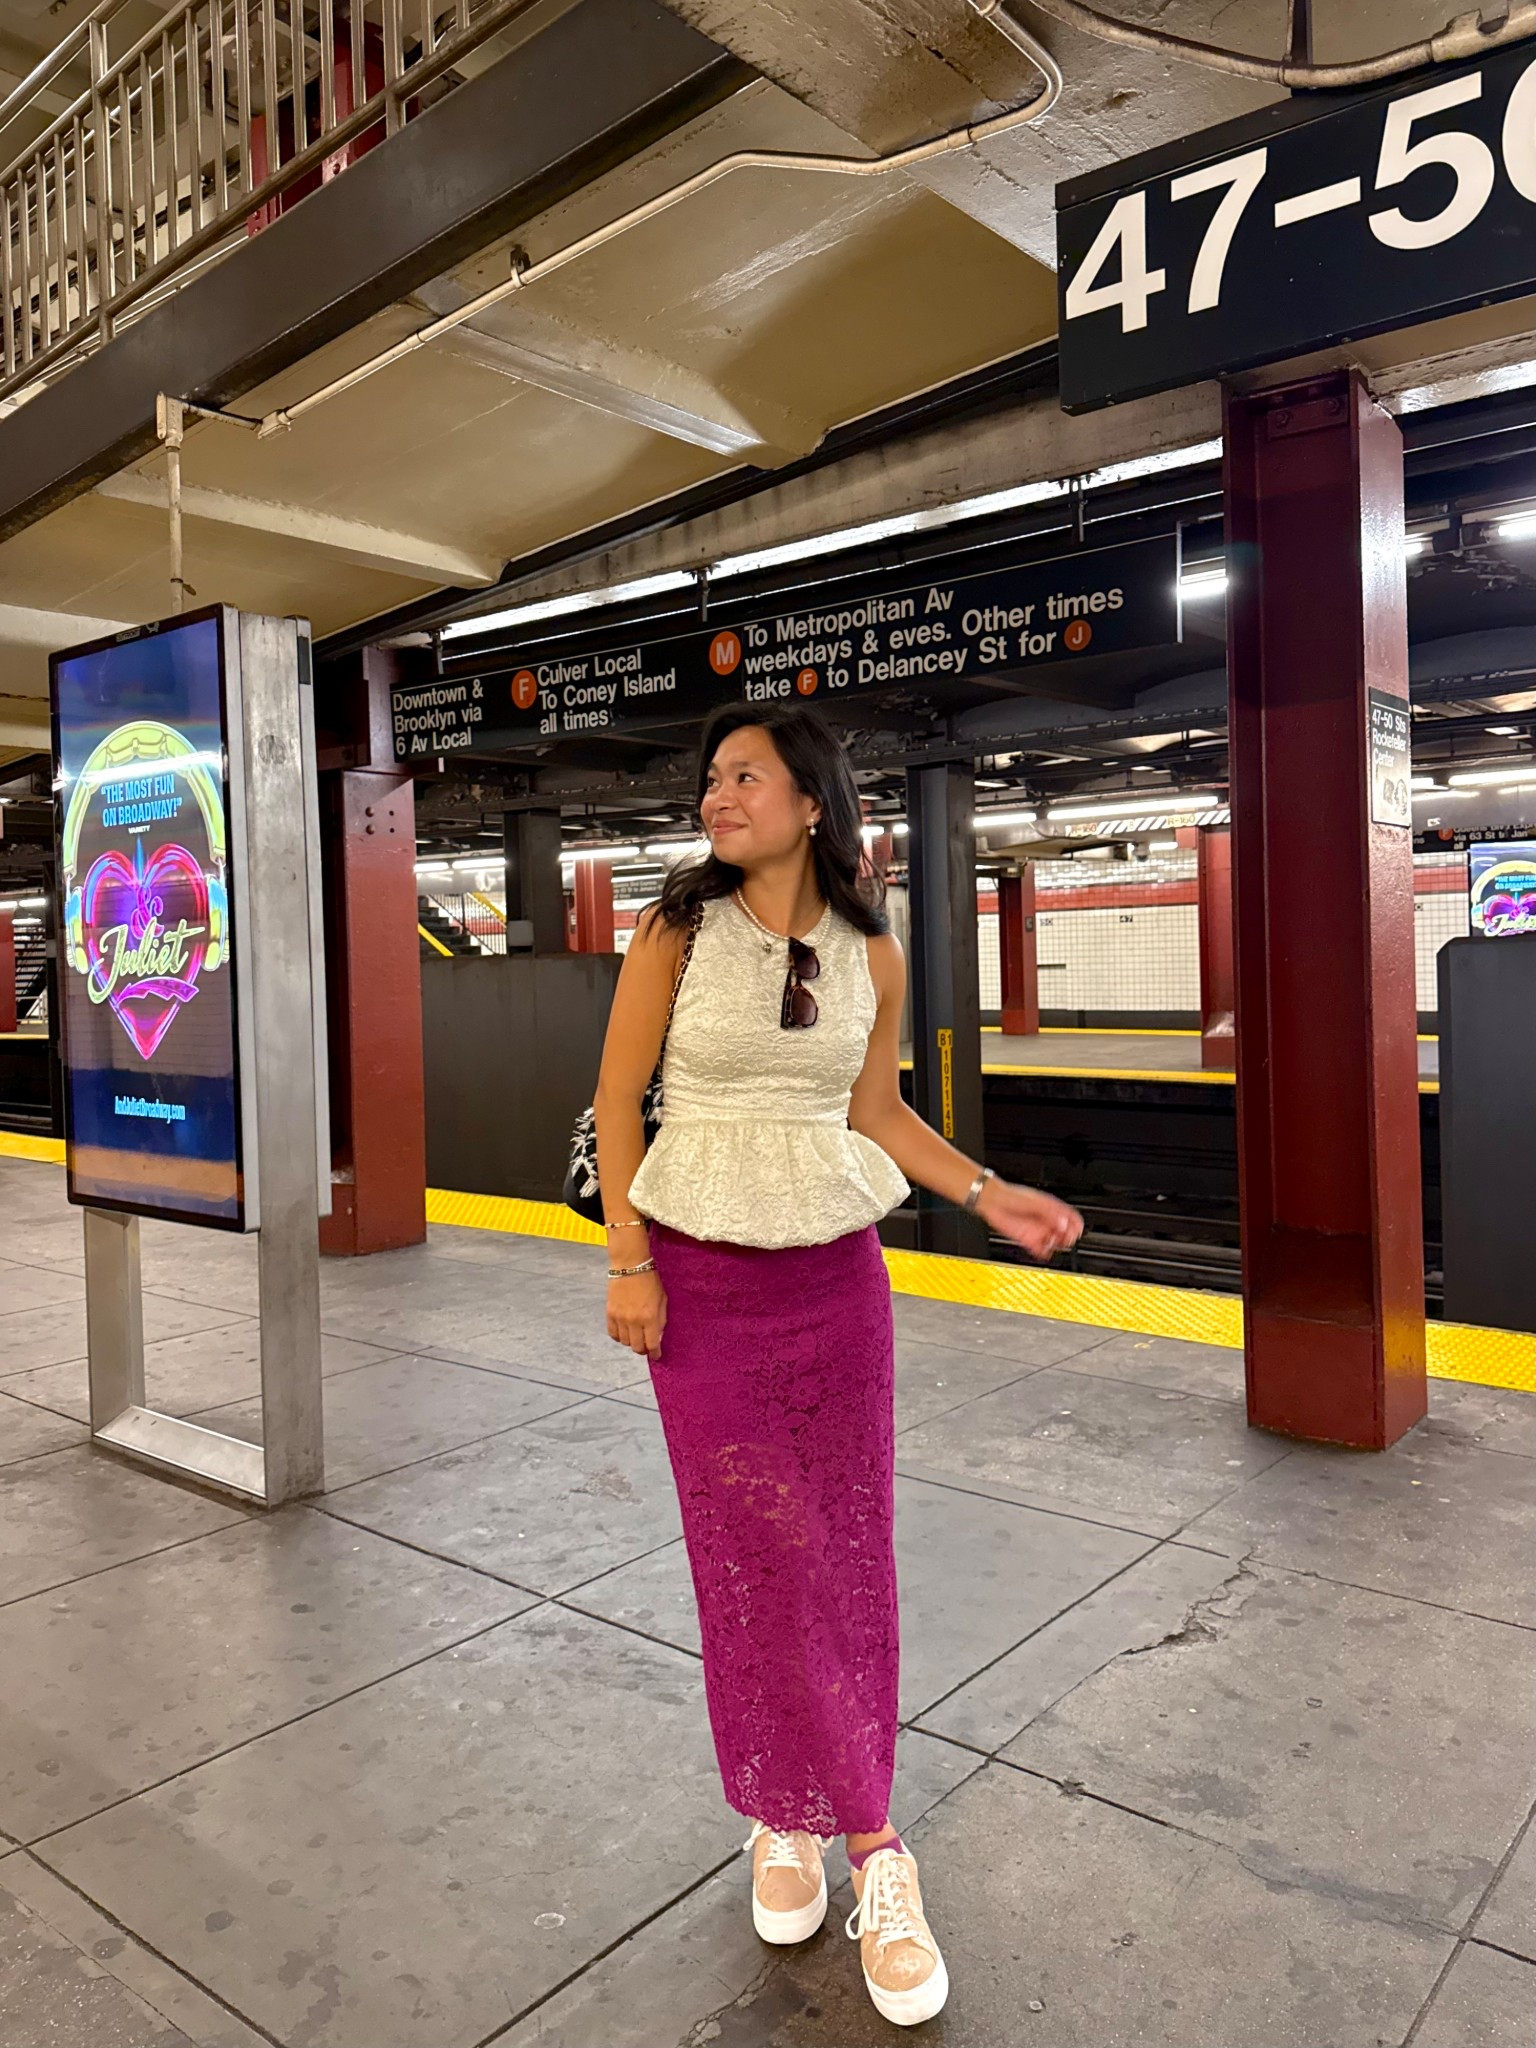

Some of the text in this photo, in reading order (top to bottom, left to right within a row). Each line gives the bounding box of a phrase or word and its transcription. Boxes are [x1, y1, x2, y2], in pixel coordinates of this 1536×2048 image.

[1066, 59, 1536, 333] 47-5
[744, 588, 954, 648] To Metropolitan Av
[744, 587, 1124, 675] weekdays & eves. Other times
[537, 648, 642, 687] Culver Local
[715, 640, 735, 666] M
[745, 676, 791, 701] take
[826, 667, 849, 688] to
[858, 648, 968, 684] Delancey
[979, 636, 1007, 664] St
[1018, 631, 1057, 657] for
[393, 679, 484, 712] Downtown &
[519, 677, 530, 700] F
[538, 667, 676, 710] To Coney Island
[394, 703, 482, 733] Brooklyn via
[540, 709, 609, 735] all times
[1372, 708, 1393, 730] 47-50
[396, 726, 472, 755] 6 Av Local
[1373, 728, 1406, 752] Rockefeller
[1373, 747, 1395, 768] Center
[125, 777, 152, 801] MOST
[154, 774, 175, 796] FUN
[103, 807, 117, 827] ON
[131, 884, 165, 940] &
[88, 917, 205, 1004] Juliet
[940, 1033, 952, 1046] B1
